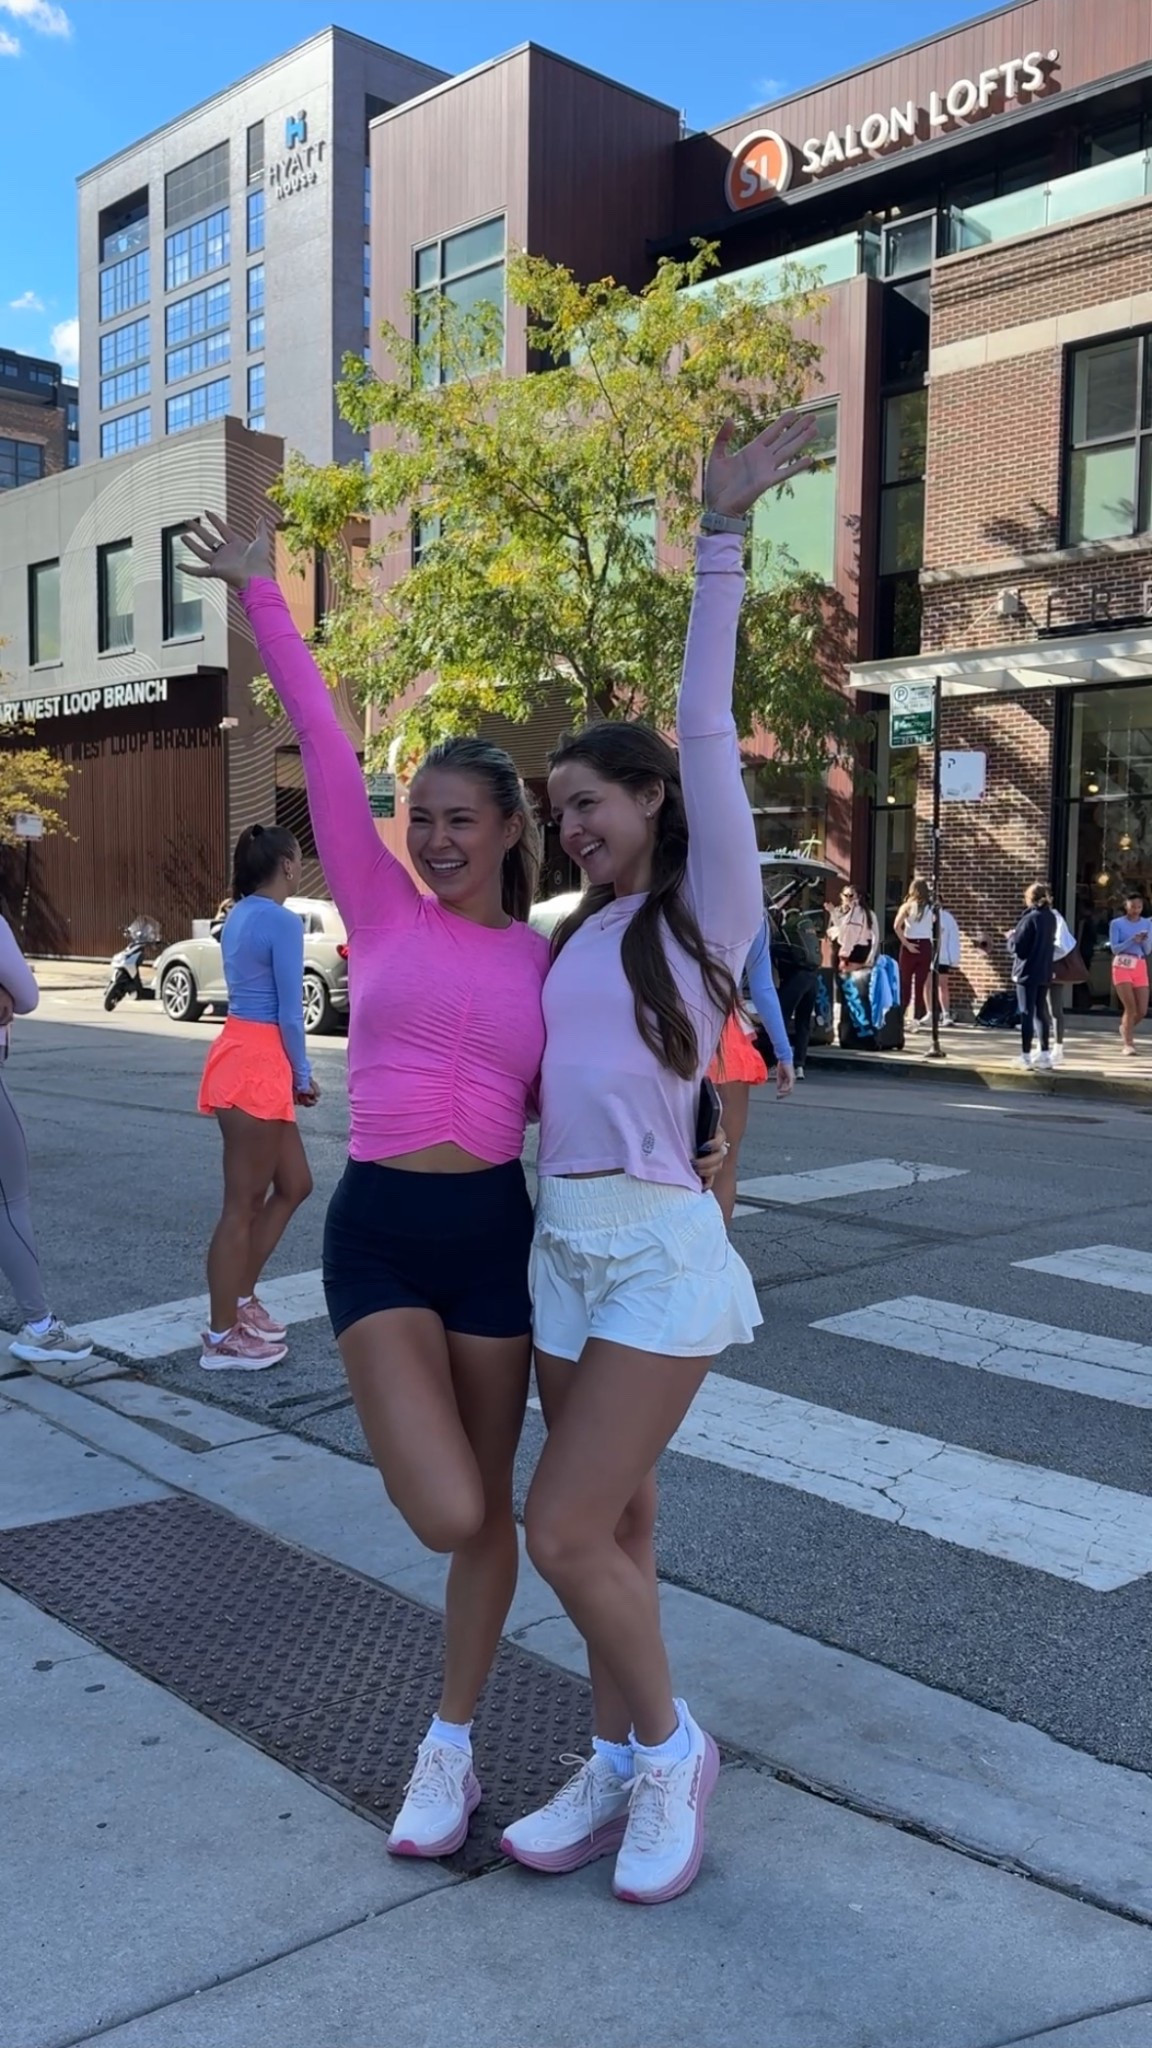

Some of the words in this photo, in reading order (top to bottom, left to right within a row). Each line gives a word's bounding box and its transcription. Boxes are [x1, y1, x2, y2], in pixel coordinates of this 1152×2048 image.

[801, 99, 916, 174] SALON
[269, 140, 326, 187] HYATT
[276, 172, 317, 200] house
[739, 154, 777, 199] SL
[23, 697, 61, 722] WEST
[63, 689, 101, 715] LOOP
[104, 678, 168, 709] BRANCH
